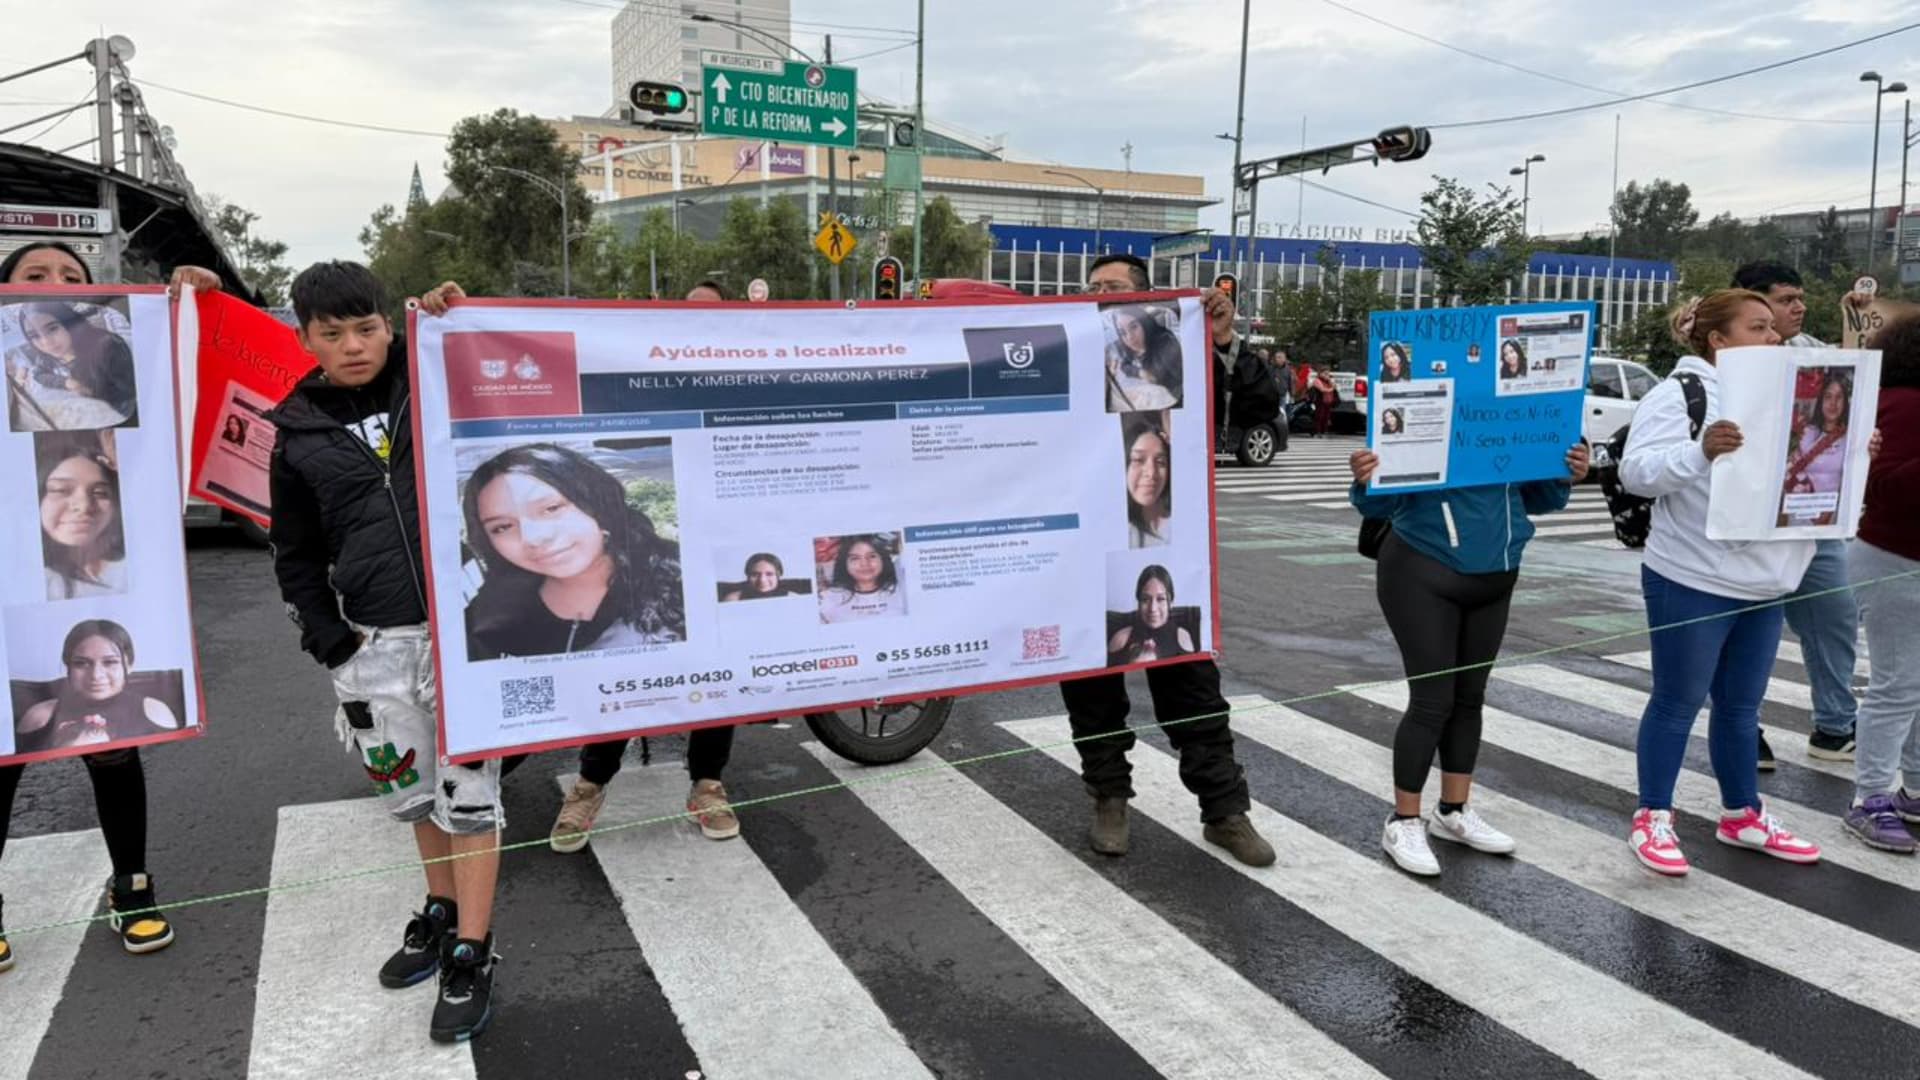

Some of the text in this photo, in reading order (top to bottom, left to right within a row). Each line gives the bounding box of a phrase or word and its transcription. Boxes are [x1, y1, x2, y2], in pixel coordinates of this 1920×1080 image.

[740, 82, 849, 111] CTO BICENTENARIO
[712, 106, 812, 133] P DE LA REFORMA
[1238, 221, 1362, 240] ESTACION
[1860, 280, 1873, 289] 50
[1371, 314, 1408, 339] NELLY
[1415, 309, 1495, 342] KIMBERLY
[649, 343, 907, 360] Ayúdanos a localizarle
[629, 368, 928, 389] NELLY KIMBERLY CARMONA PEREZ
[713, 414, 770, 422] Información
[713, 434, 739, 442] Fecha
[742, 433, 752, 441] de
[713, 443, 739, 452] Lugar
[741, 441, 752, 449] de
[715, 467, 779, 478] Circunstancias
[891, 640, 989, 661] 55 5658 1111
[752, 659, 818, 678] locatel
[615, 669, 733, 693] 55 5484 0430
[706, 690, 728, 699] SSC
